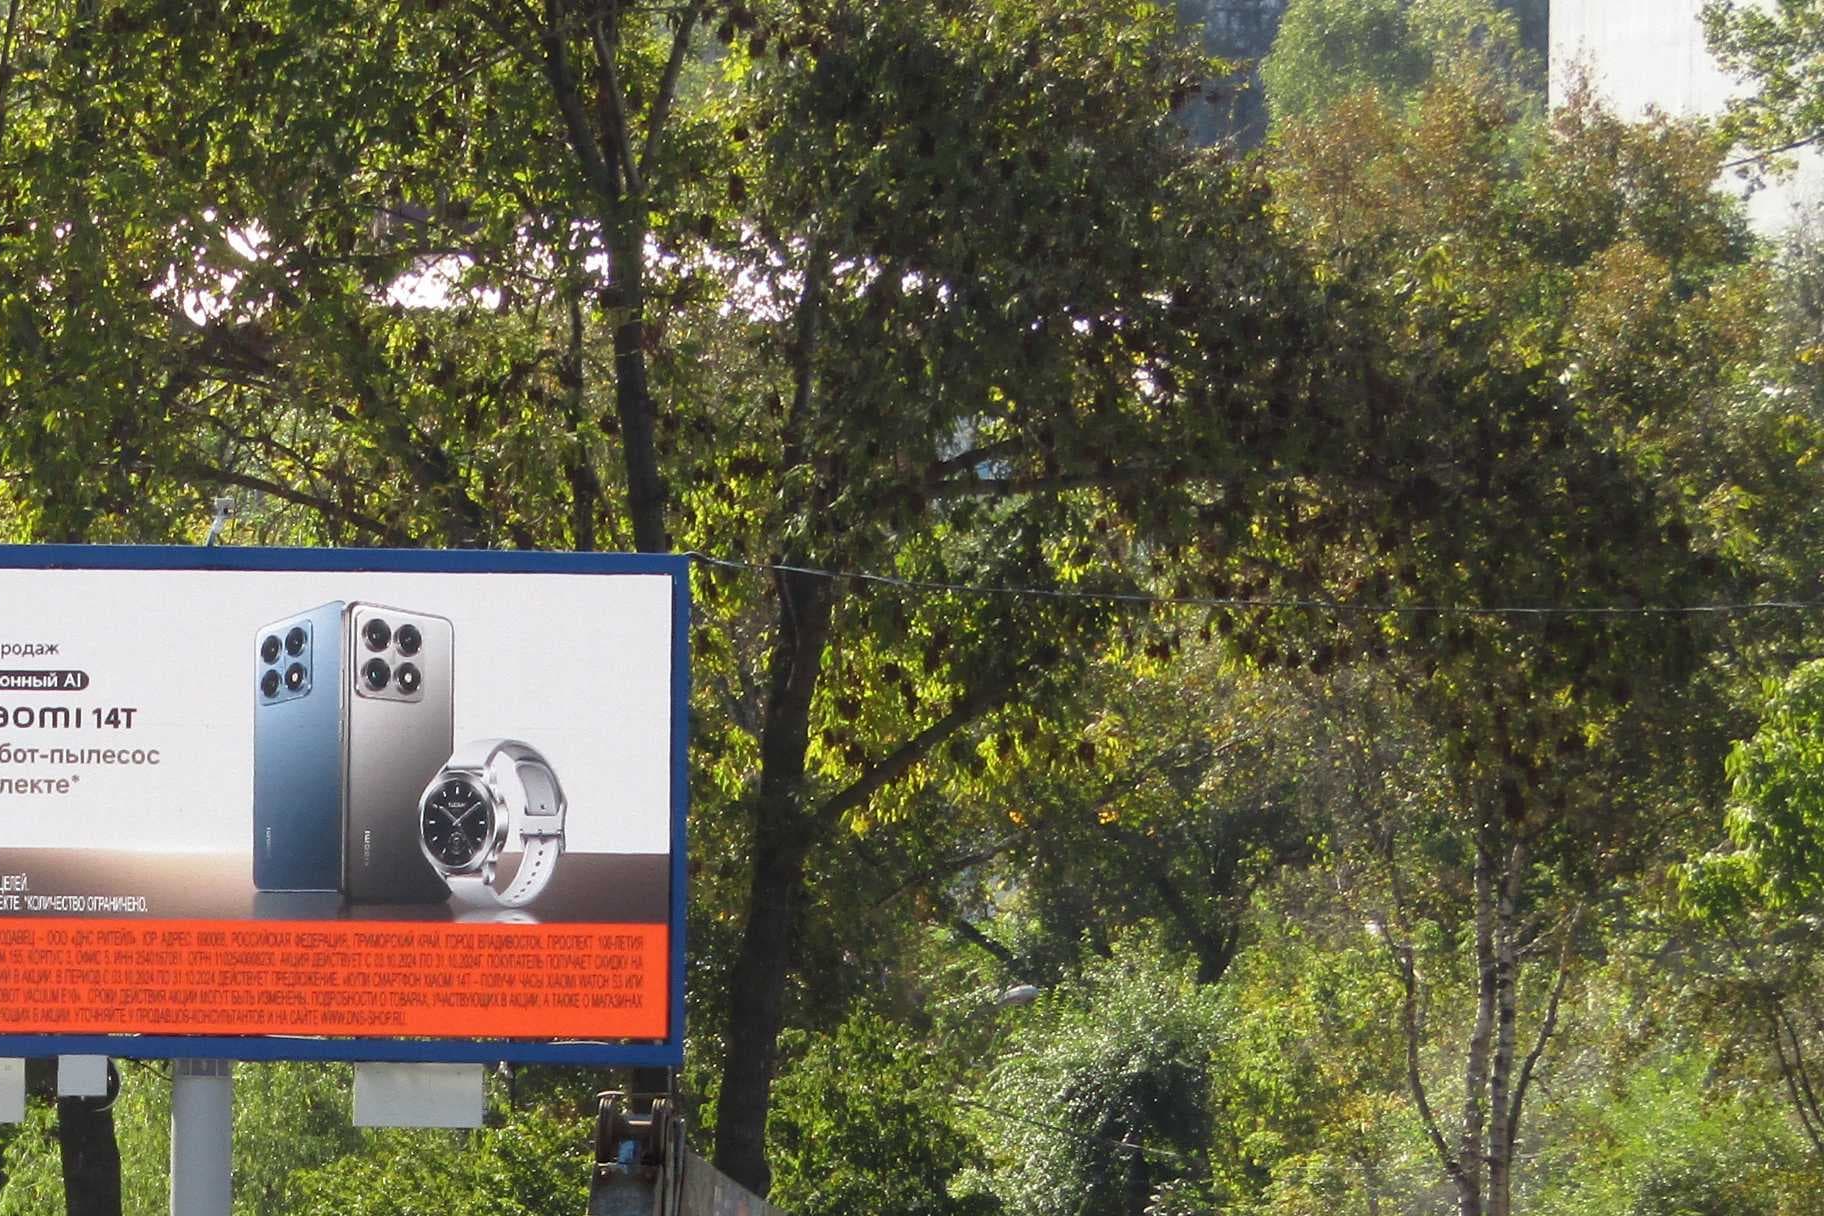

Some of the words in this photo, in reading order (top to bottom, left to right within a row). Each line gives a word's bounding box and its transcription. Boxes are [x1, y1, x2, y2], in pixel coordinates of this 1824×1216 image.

[64, 673, 81, 689] AI
[92, 707, 137, 729] 14T
[87, 896, 148, 913] ОГРАНИЧЕНО.
